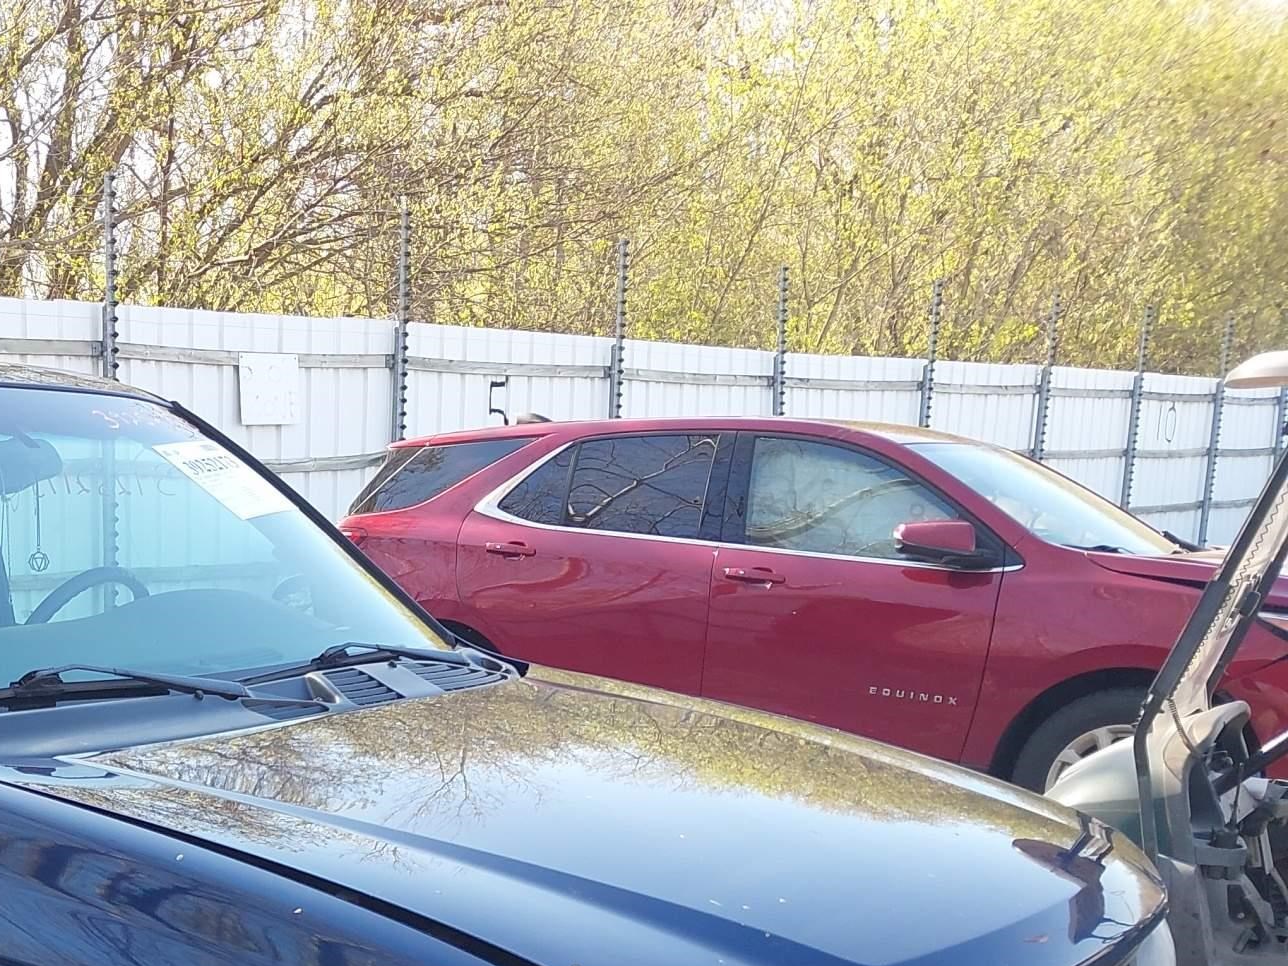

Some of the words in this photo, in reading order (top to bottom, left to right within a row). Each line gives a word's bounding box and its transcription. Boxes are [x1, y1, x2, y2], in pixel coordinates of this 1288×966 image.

[488, 375, 509, 426] 5
[1156, 401, 1177, 443] 10
[869, 686, 958, 706] EQUINOX
